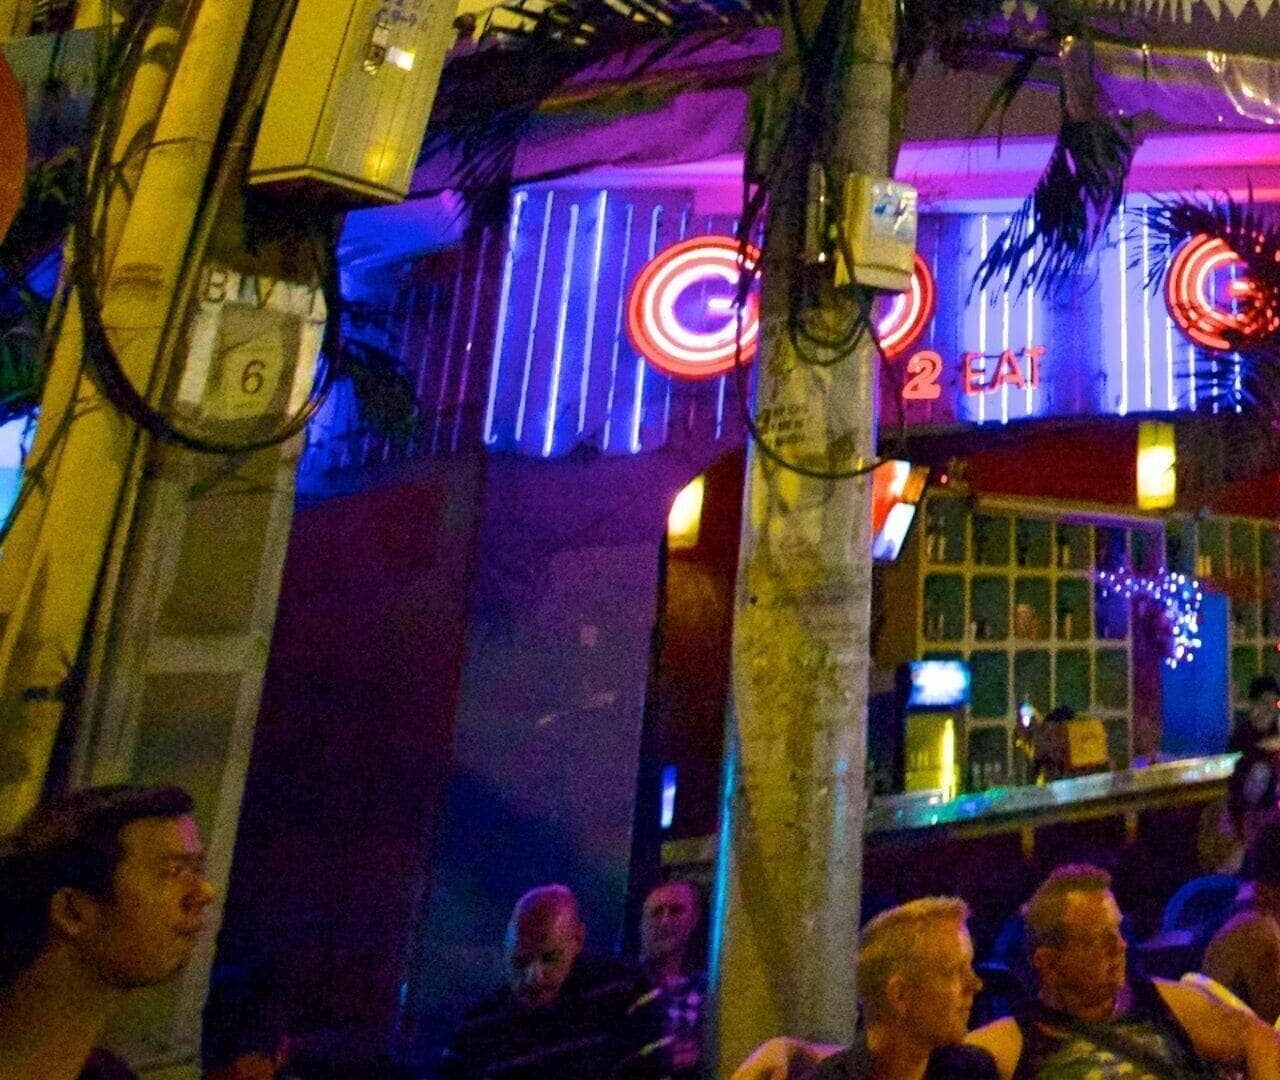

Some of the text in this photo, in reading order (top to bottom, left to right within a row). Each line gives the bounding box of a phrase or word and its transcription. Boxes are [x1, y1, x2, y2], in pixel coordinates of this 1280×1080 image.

[240, 359, 267, 395] 6
[901, 350, 944, 400] 2
[961, 345, 1048, 396] EAT
